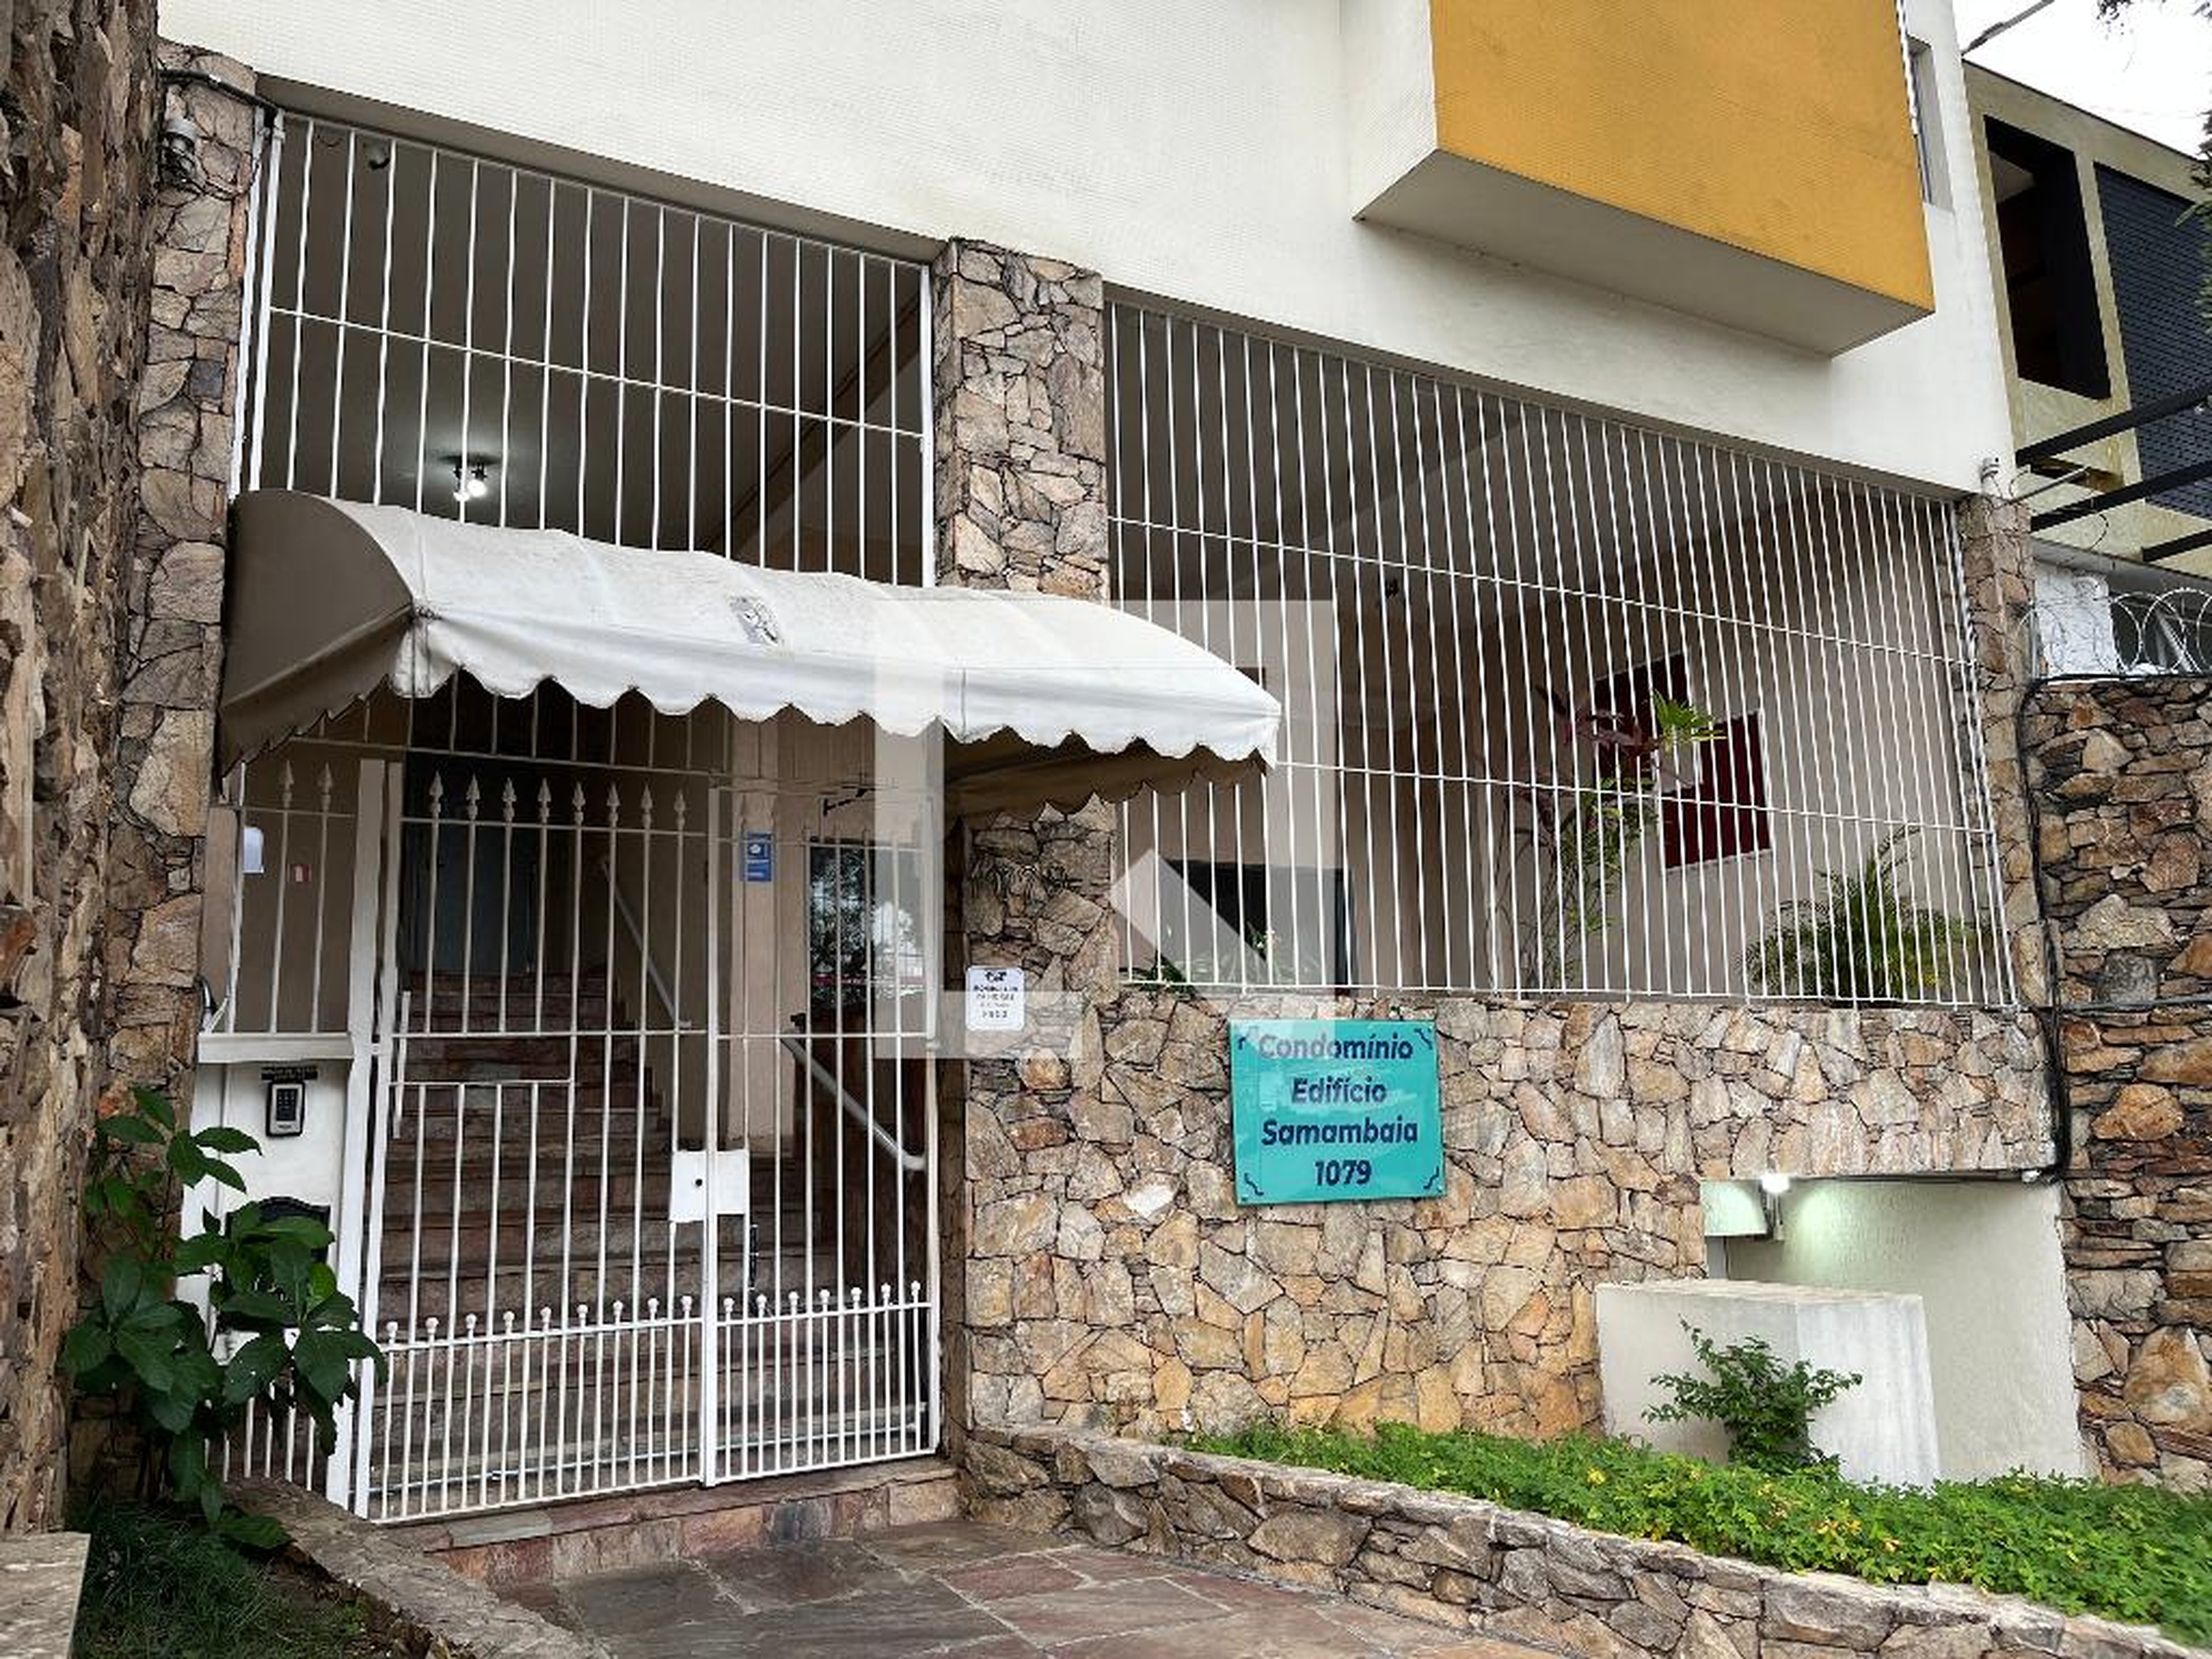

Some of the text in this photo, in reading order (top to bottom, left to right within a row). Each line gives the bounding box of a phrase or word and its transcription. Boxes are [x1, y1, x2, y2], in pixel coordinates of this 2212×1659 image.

[1259, 1032, 1413, 1059] Condomínio
[1291, 1075, 1387, 1104] Edifício
[1261, 1115, 1418, 1146] Samambaia
[1315, 1160, 1372, 1187] 1079
